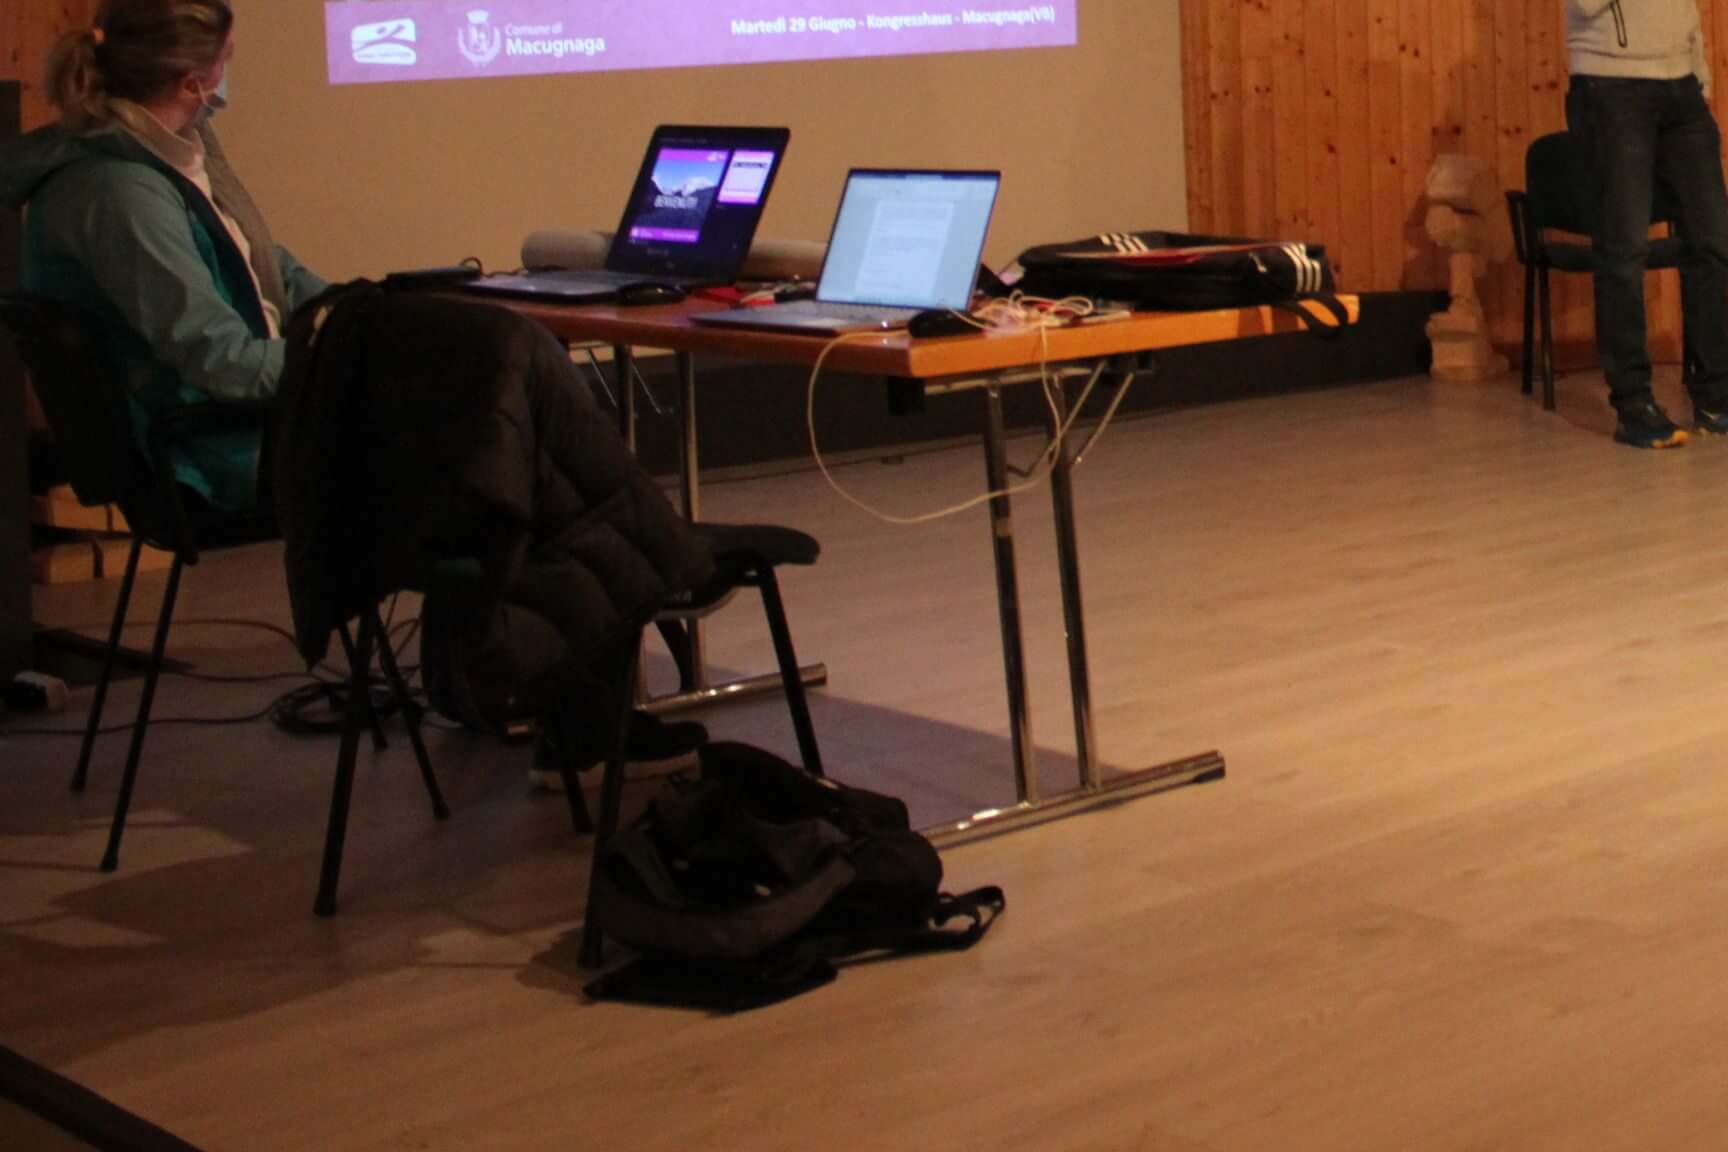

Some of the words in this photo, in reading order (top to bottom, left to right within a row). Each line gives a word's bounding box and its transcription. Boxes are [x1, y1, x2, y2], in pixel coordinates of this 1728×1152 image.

[504, 23, 551, 36] Comune
[552, 21, 563, 34] di
[789, 17, 806, 33] 29
[808, 16, 856, 35] Giugno
[866, 12, 952, 32] Kongresshaus
[505, 36, 607, 58] Macugnaga
